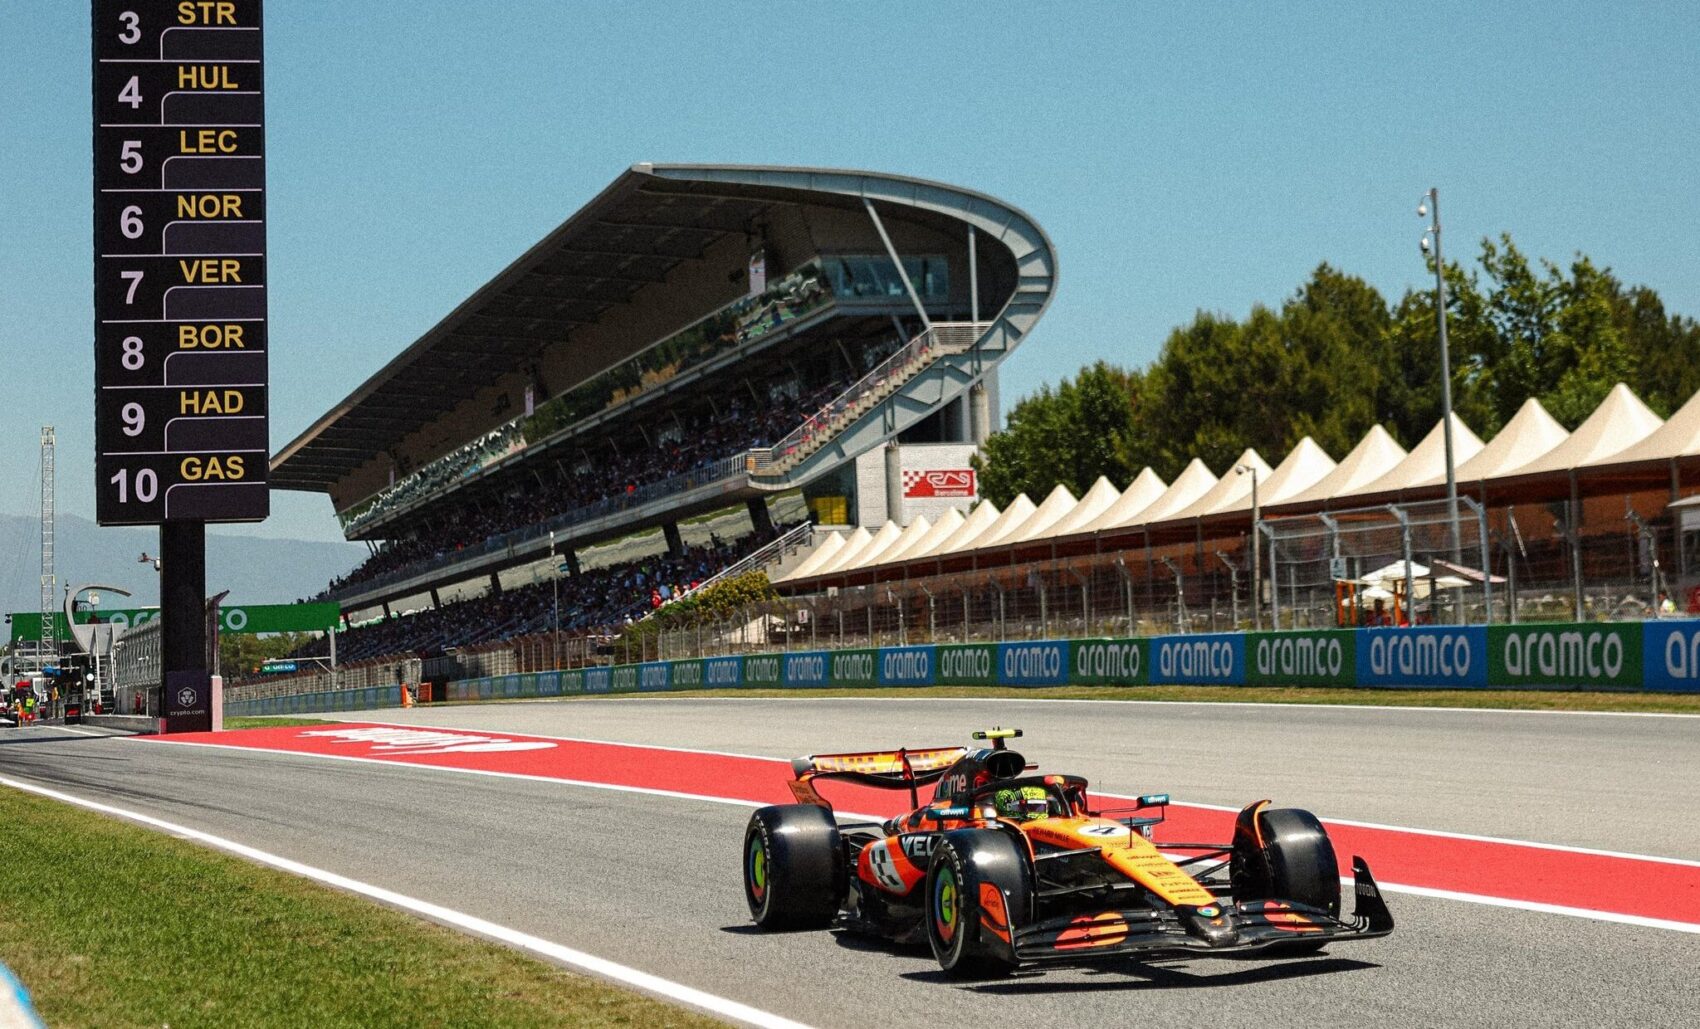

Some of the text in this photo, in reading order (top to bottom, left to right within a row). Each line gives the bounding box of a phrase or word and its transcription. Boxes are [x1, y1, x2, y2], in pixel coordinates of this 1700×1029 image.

[119, 2, 235, 44] 3 STR
[119, 67, 237, 108] 4 HUL
[121, 131, 237, 174] 5 LEC
[121, 195, 241, 239] 6 NOR
[121, 260, 241, 304] 7 VER
[122, 325, 244, 370] 8 BOR
[122, 391, 244, 436] 9 HAD
[111, 457, 244, 502] 10 GAS
[747, 659, 778, 681] aramco
[787, 656, 822, 680] aramco
[834, 654, 872, 680] aramco
[884, 651, 928, 679] aramco
[942, 648, 989, 677] aramco
[1005, 647, 1059, 677] aramco
[1077, 644, 1139, 677] aramco
[1160, 642, 1232, 676] aramco
[1257, 638, 1341, 676] aramco
[1371, 635, 1470, 676] aramco
[1505, 632, 1623, 677] aramco
[901, 836, 936, 857] VEL
